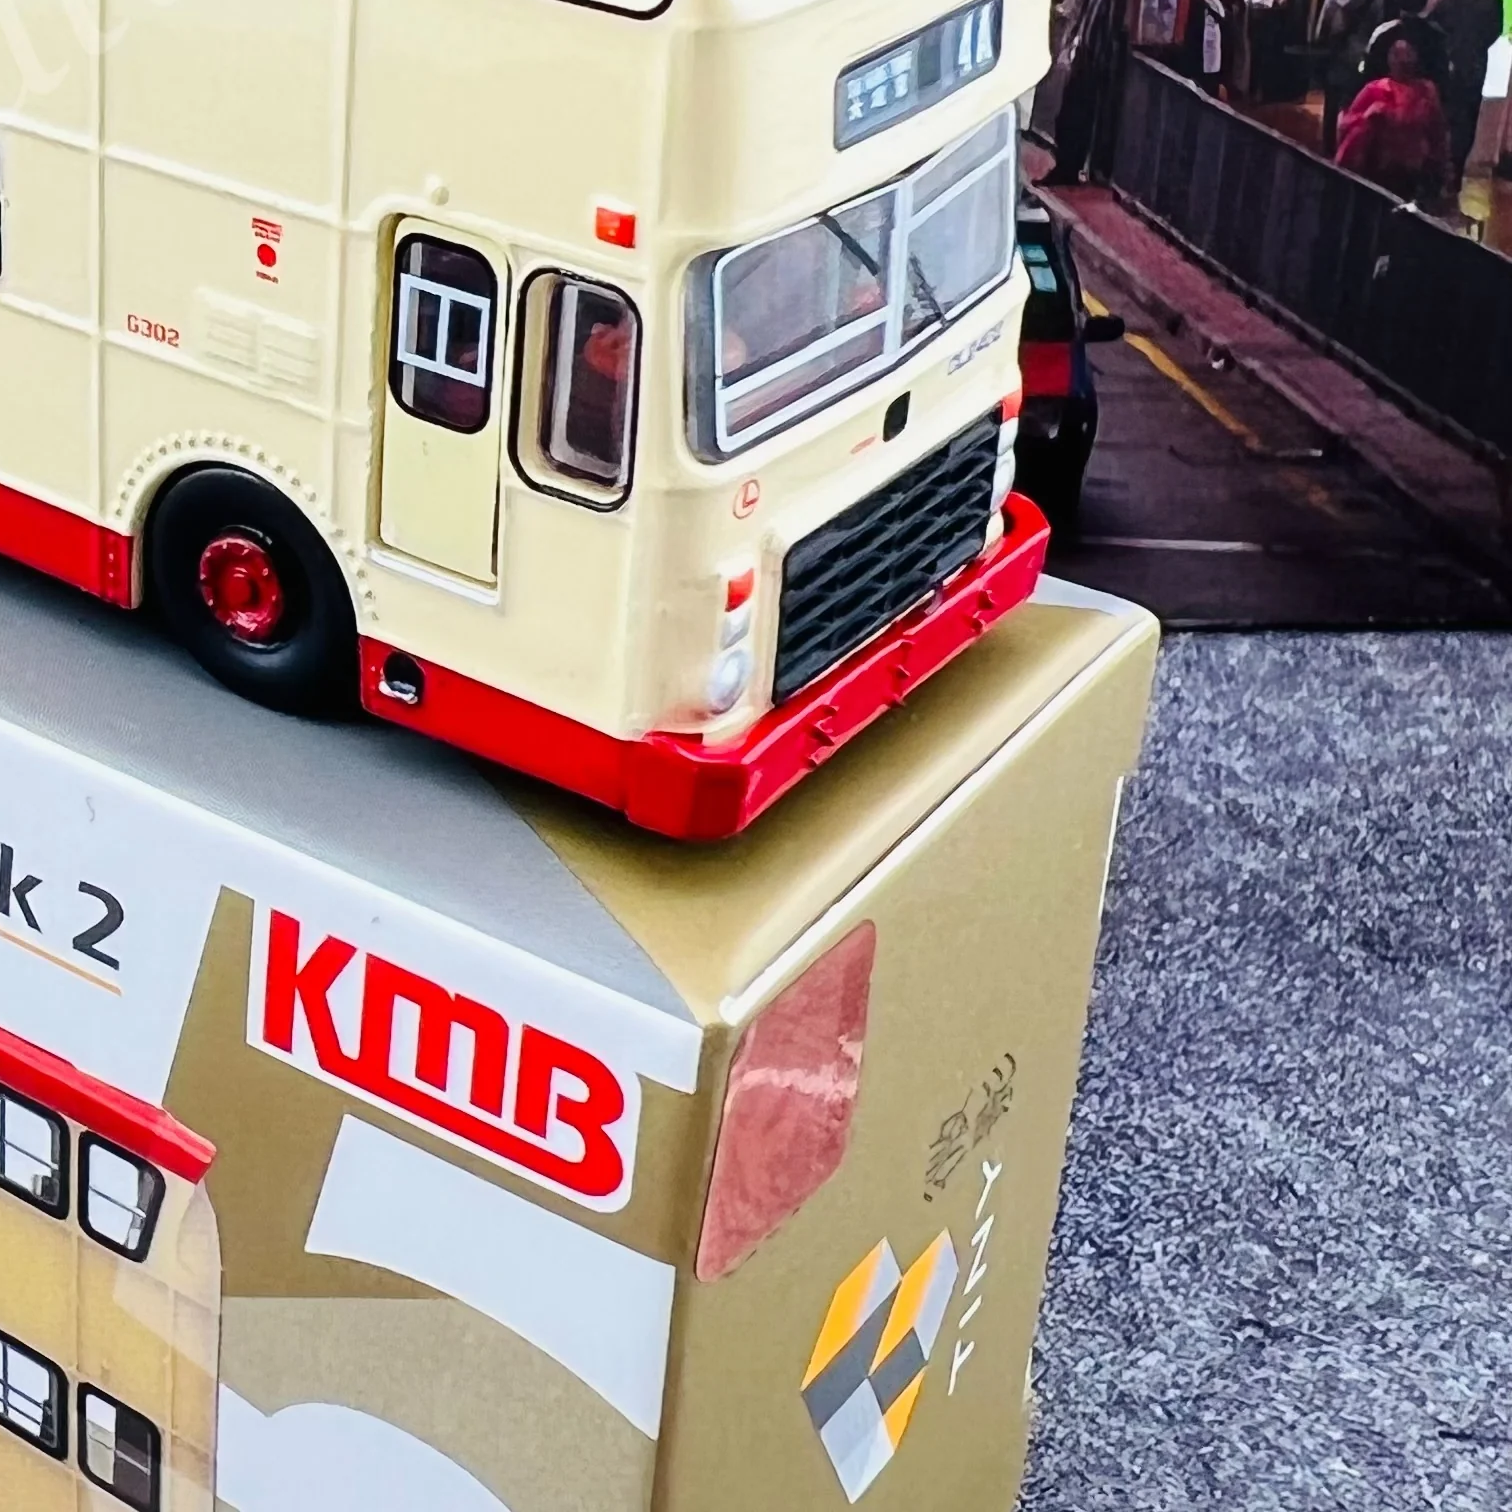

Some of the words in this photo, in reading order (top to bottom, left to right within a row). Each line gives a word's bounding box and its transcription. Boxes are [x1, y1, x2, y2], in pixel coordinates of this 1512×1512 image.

[71, 881, 125, 971] 2
[263, 906, 625, 1198] KMB
[947, 1160, 1003, 1397] TINY
